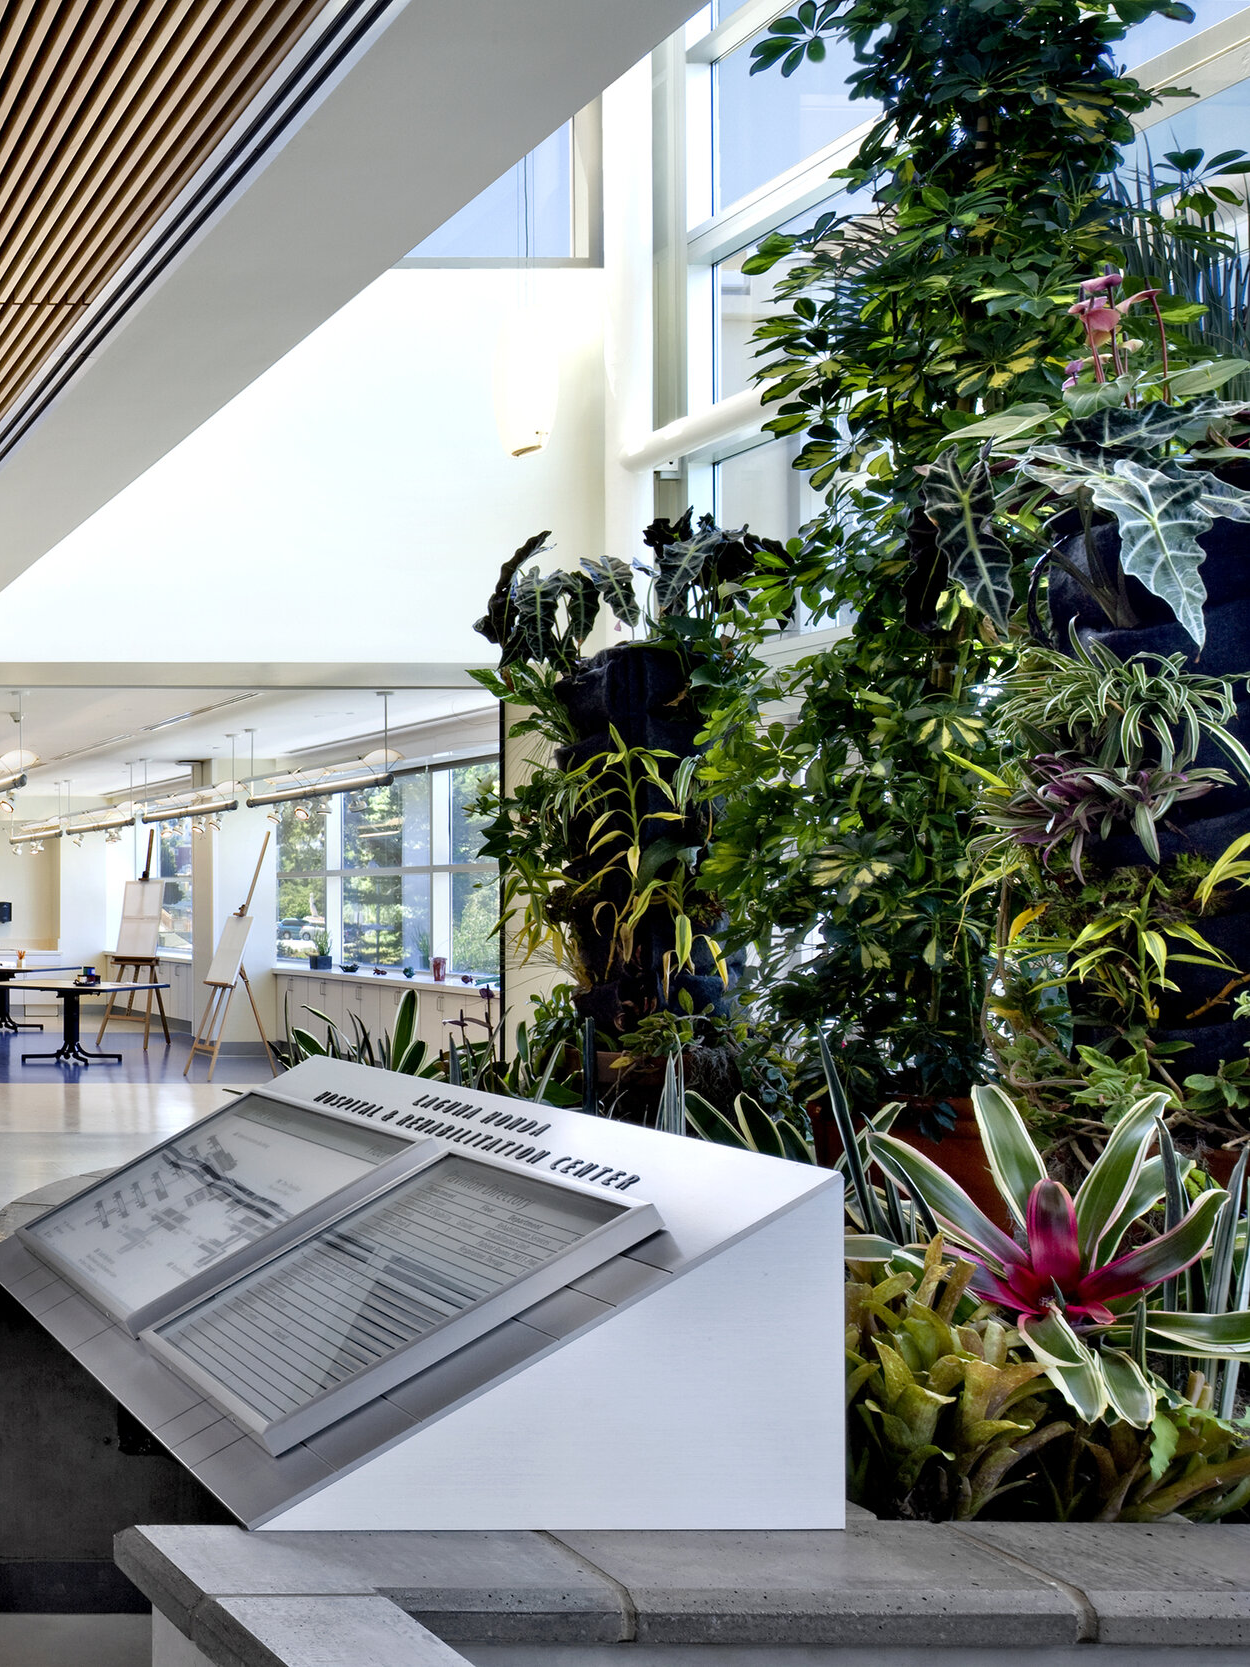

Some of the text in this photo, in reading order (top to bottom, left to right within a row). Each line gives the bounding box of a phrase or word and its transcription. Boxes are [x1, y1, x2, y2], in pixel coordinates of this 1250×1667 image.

[412, 1094, 552, 1137] LAGUNA HONDA
[313, 1090, 384, 1118] HOSPITAL
[381, 1109, 399, 1122] &
[396, 1113, 551, 1165] REHABILITATION
[549, 1156, 641, 1191] CENTER
[443, 1170, 535, 1211] Pavilion Directory
[507, 1214, 544, 1231] Department
